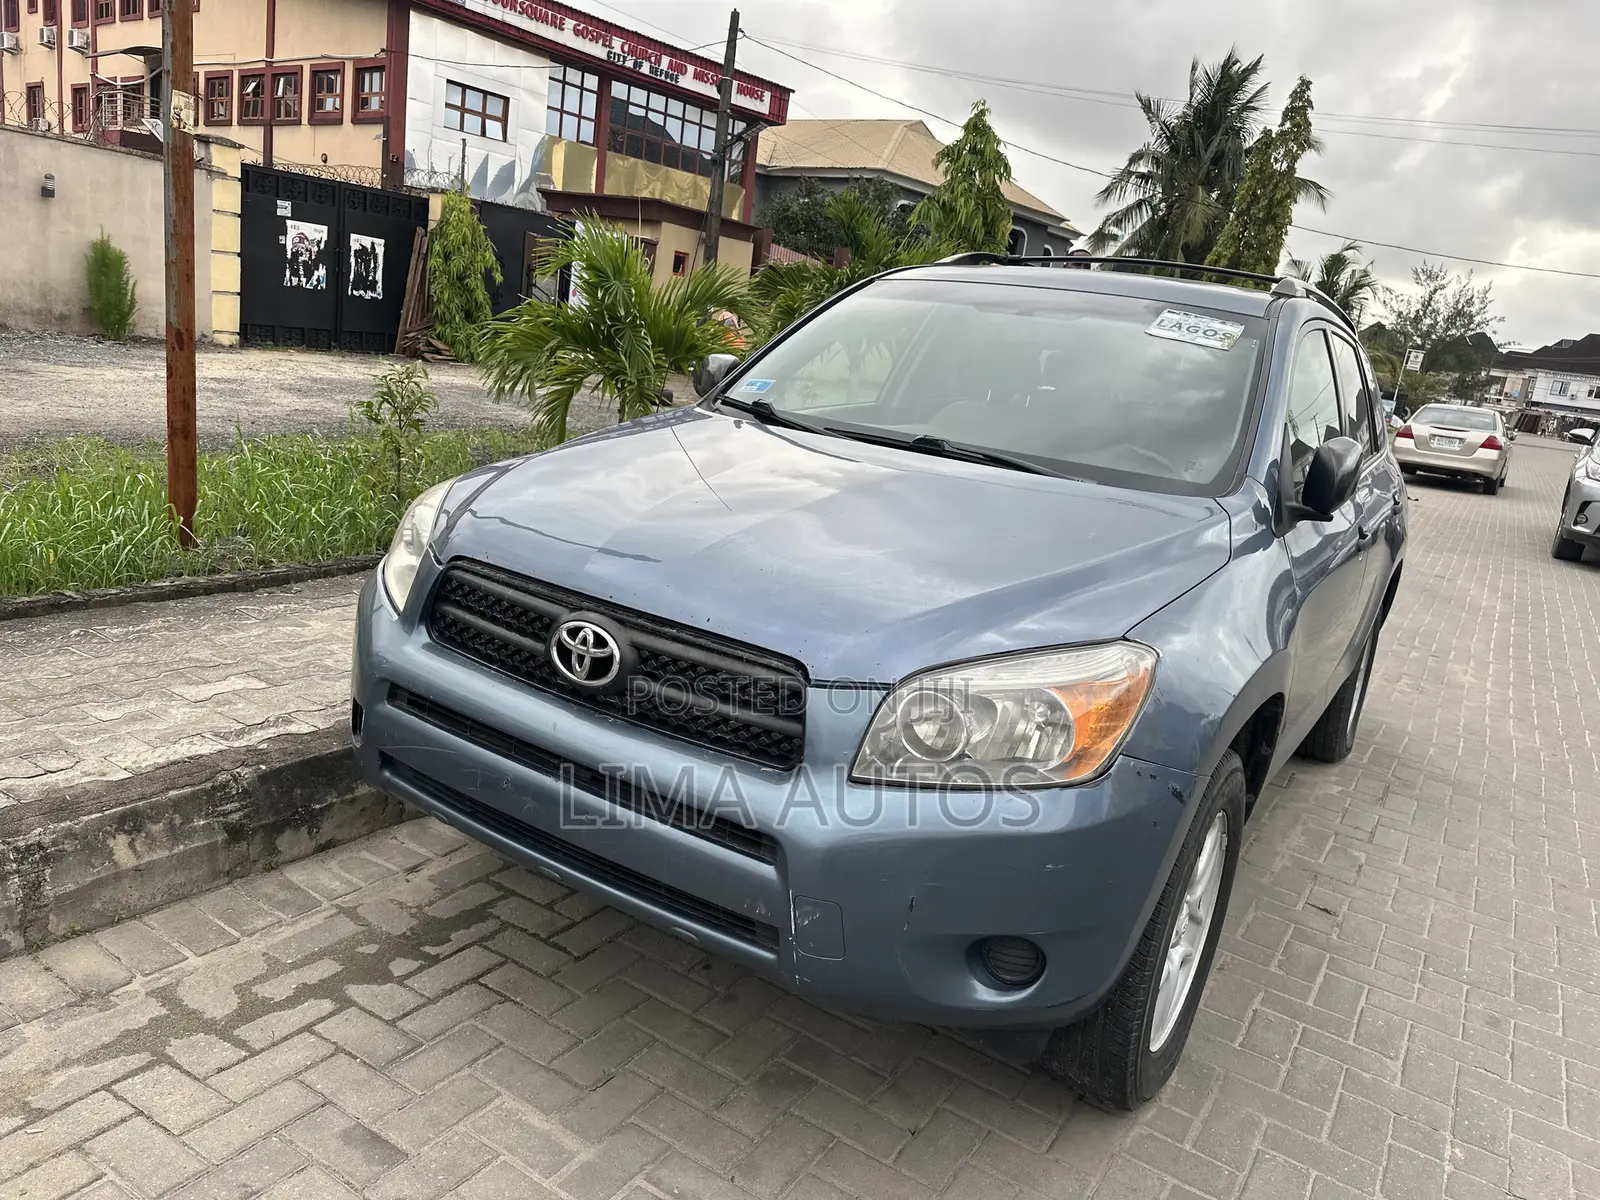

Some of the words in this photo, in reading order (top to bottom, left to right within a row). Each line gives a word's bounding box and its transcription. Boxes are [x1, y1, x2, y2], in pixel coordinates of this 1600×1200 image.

[483, 0, 567, 31] URSQUARE
[573, 23, 615, 49] GOSPEL
[620, 41, 663, 67] CHURCH
[667, 58, 689, 76] AND
[692, 67, 722, 87] MISSI
[736, 81, 766, 102] HOUSE
[606, 49, 628, 65] CITY
[633, 58, 645, 71] OF
[649, 63, 680, 84] REFUGE
[1155, 318, 1234, 341] LAGOS
